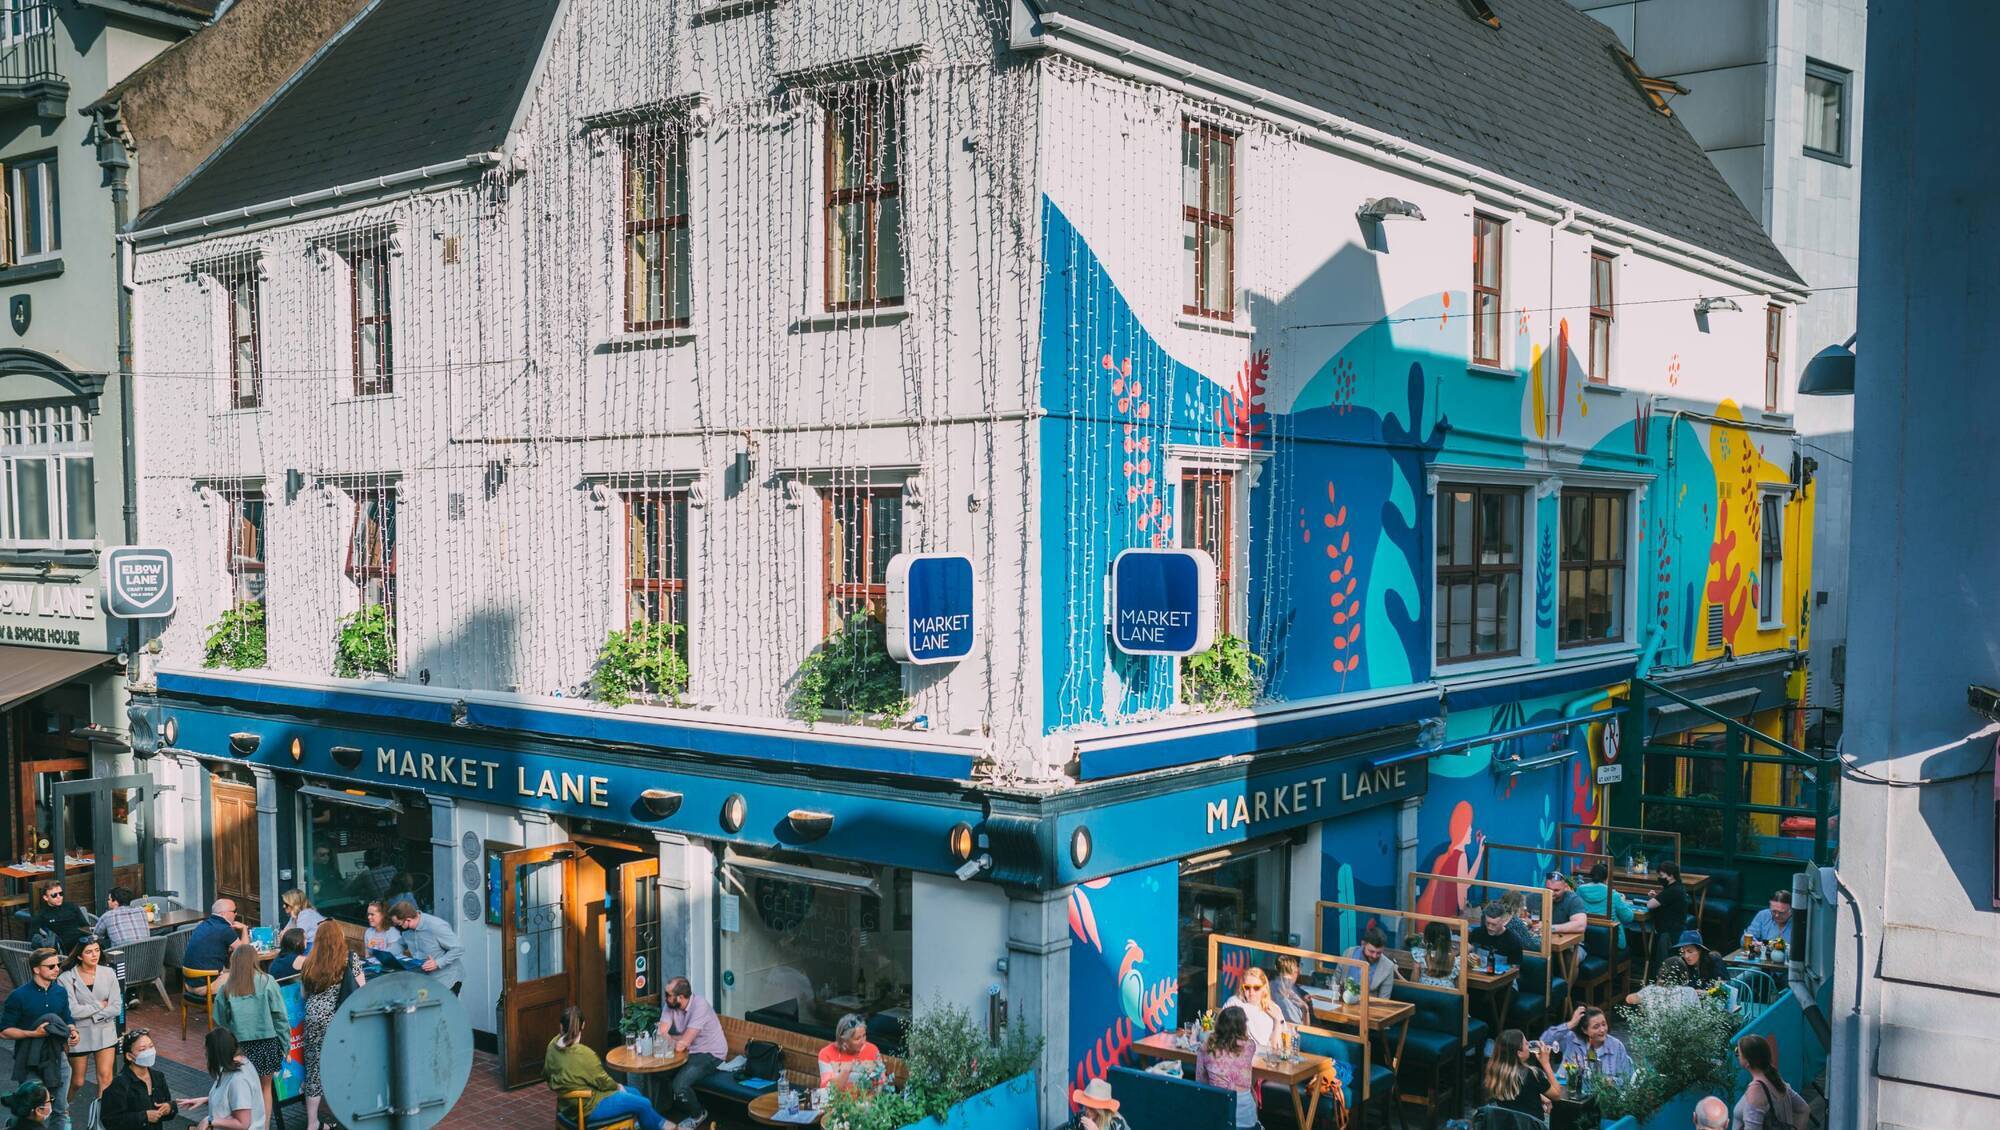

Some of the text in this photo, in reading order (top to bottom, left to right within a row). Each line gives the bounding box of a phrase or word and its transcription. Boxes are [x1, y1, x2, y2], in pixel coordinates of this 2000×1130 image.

[122, 564, 162, 575] ELBOW
[126, 575, 158, 585] LANE
[38, 585, 95, 619] LANE
[913, 614, 970, 634] MARKET
[1121, 609, 1192, 627] MARKET
[15, 626, 46, 643] SMOKE
[47, 629, 80, 645] HOUSE
[913, 633, 950, 652] LANE
[1121, 627, 1165, 643] LANE
[377, 747, 609, 807] MARKET LANE
[1207, 764, 1407, 834] MARKET LANE
